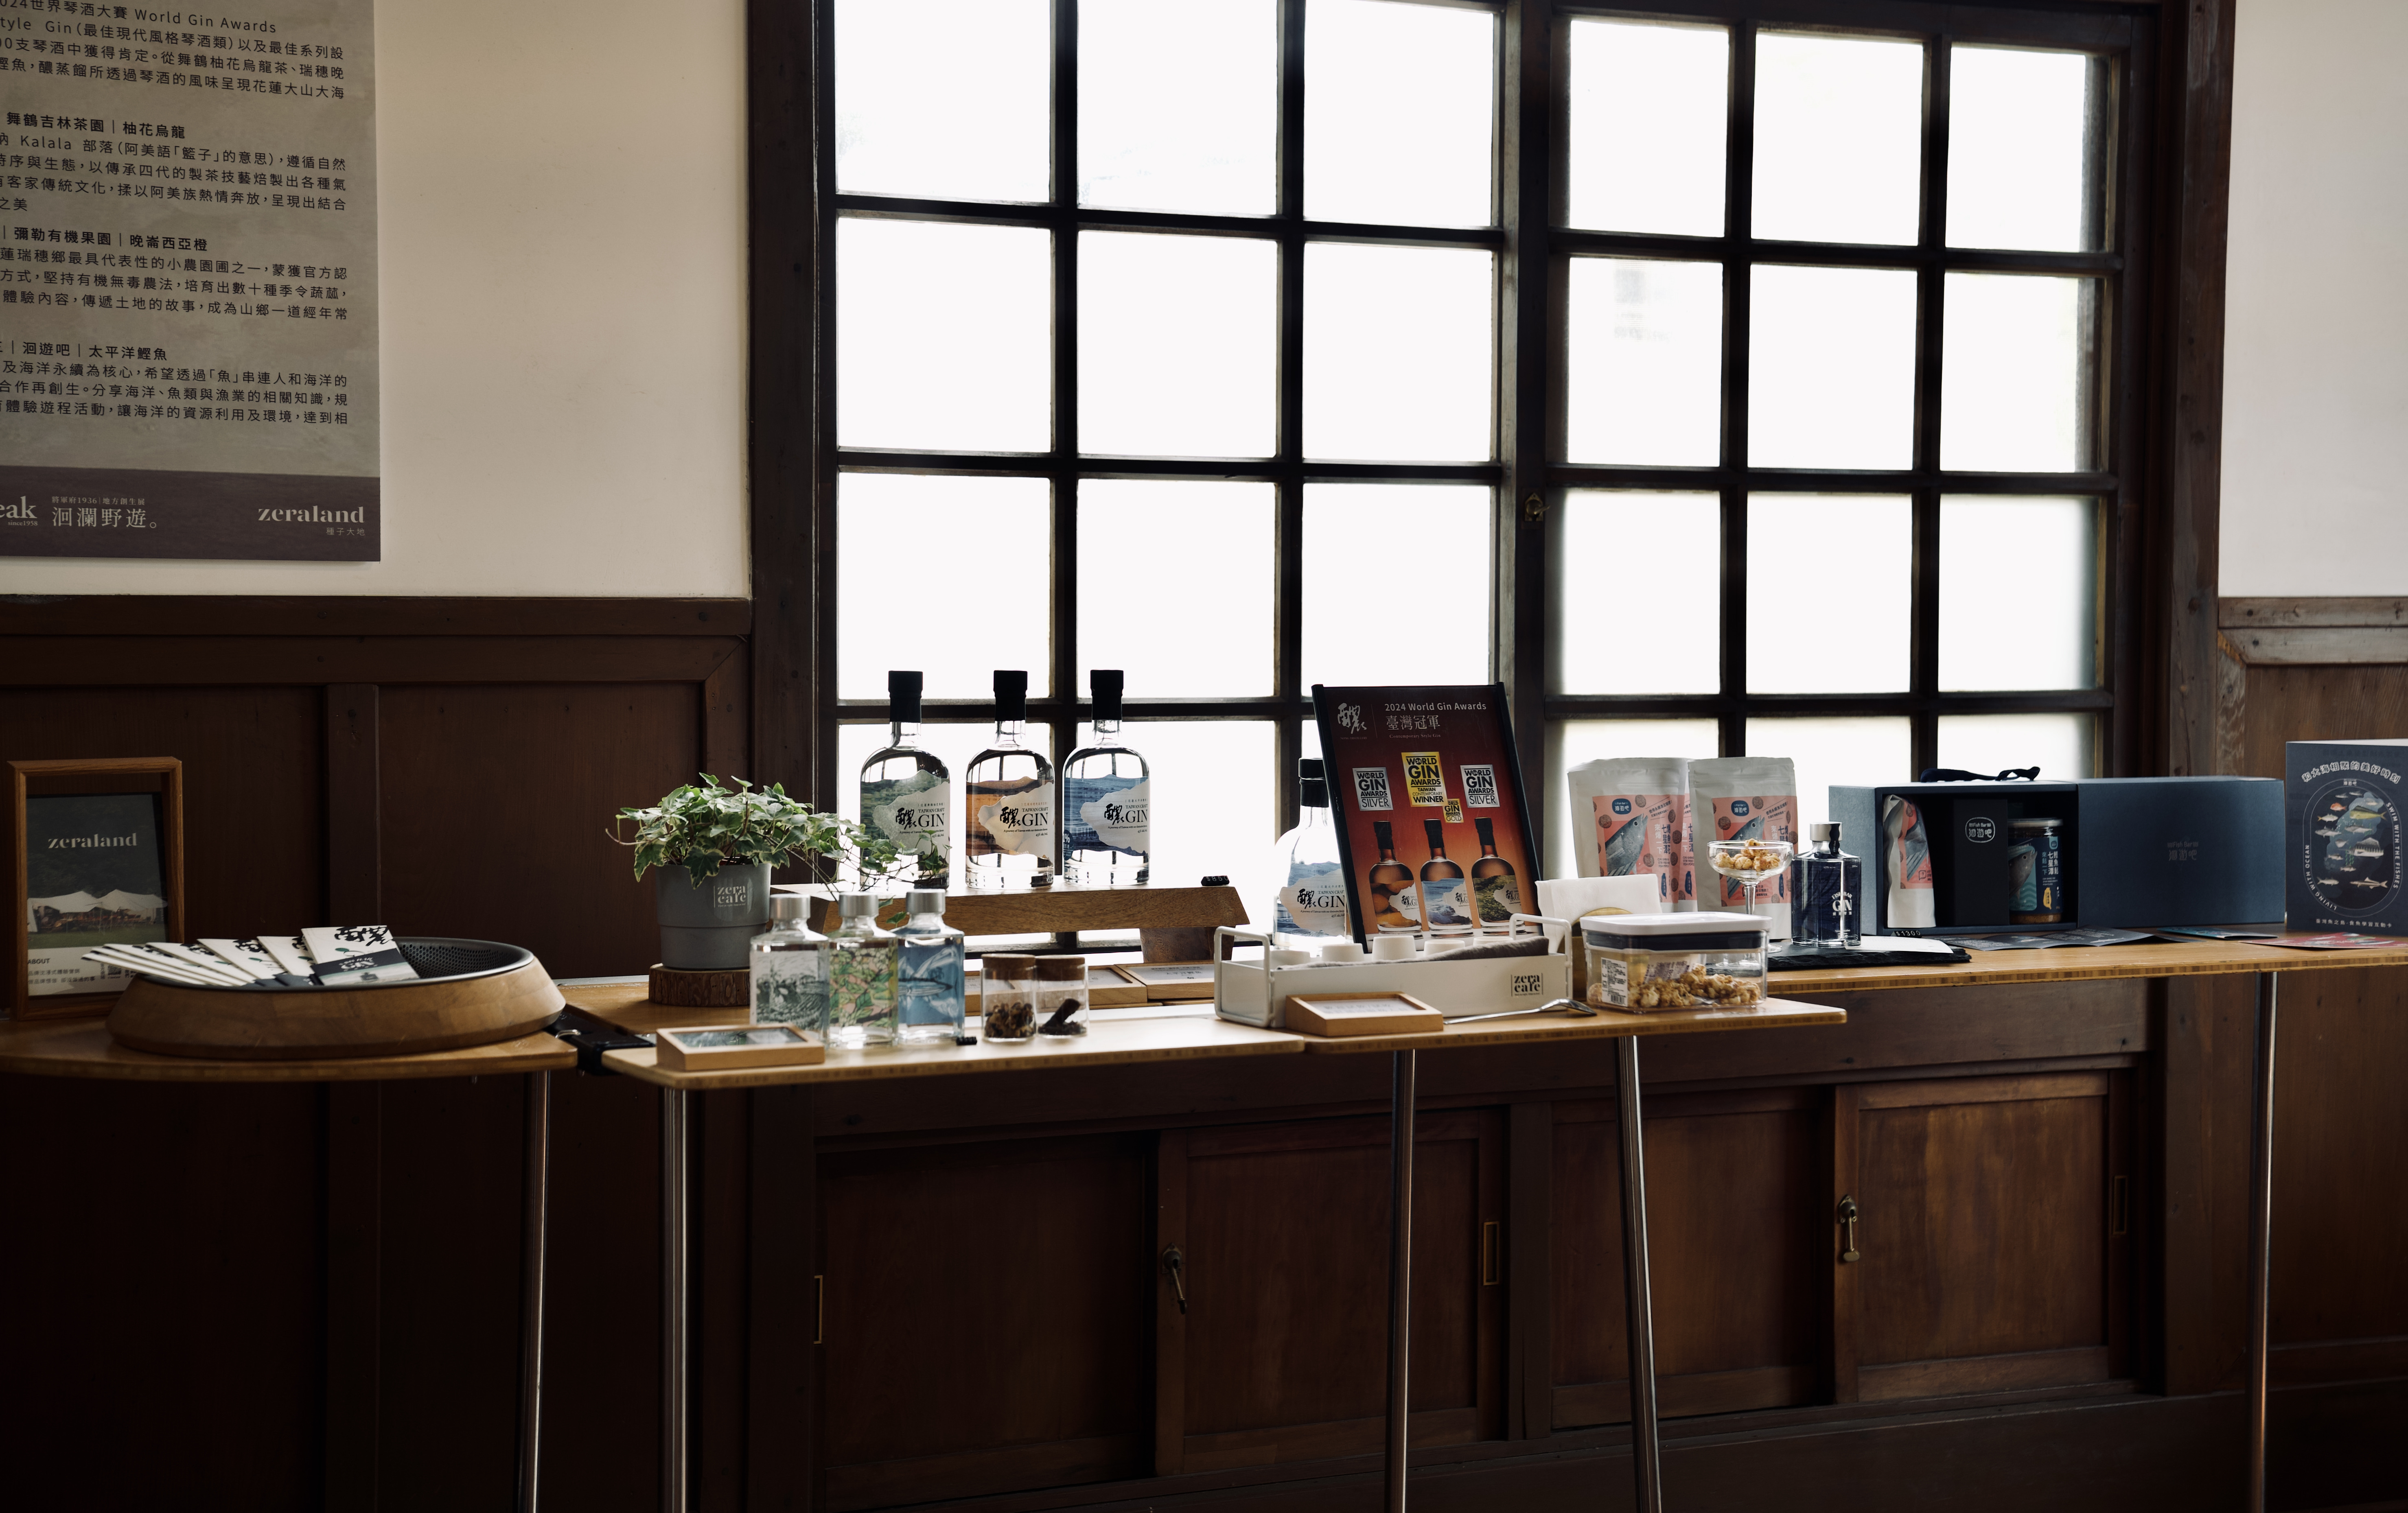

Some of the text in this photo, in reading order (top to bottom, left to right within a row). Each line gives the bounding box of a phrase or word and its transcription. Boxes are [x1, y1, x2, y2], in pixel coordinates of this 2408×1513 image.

[135, 9, 181, 24] World
[188, 14, 213, 27] Gin
[220, 17, 276, 33] Awards
[0, 37, 344, 80] 0支琴酒中獲得肯定。從舞鶴柚花烏龍茶、瑞穗晚
[21, 135, 71, 150] Kalala
[0, 175, 346, 211] 客家傳統文化,揉以阿美族熱情奔放,呈現出結合
[0, 198, 27, 211] 之美
[258, 505, 365, 523] zeraland
[326, 527, 365, 536] 種子大地
[1408, 702, 1435, 711] World
[1454, 702, 1486, 710] Awards
[1386, 715, 1440, 730] 臺灣冠軍
[1408, 765, 1440, 778] GIN
[2301, 761, 2401, 784] 和大海相聚的美好時刻
[1359, 779, 1386, 791] GIN
[1467, 776, 1493, 788] GIN
[1362, 798, 1389, 807] SILVER
[1469, 796, 1496, 804] SILVER
[1022, 812, 1048, 826] GIN
[1125, 809, 1147, 823] GIN
[2386, 802, 2398, 822] SWIM
[918, 813, 944, 827] GIN
[48, 833, 138, 849] zeraland
[2305, 871, 2316, 890] WITH
[718, 885, 746, 895] zera
[718, 892, 746, 903] cafe
[1318, 895, 1344, 907] GIN
[2315, 891, 2337, 911] LIVING
[1514, 975, 1540, 984] zera
[1514, 981, 1540, 993] cafe
